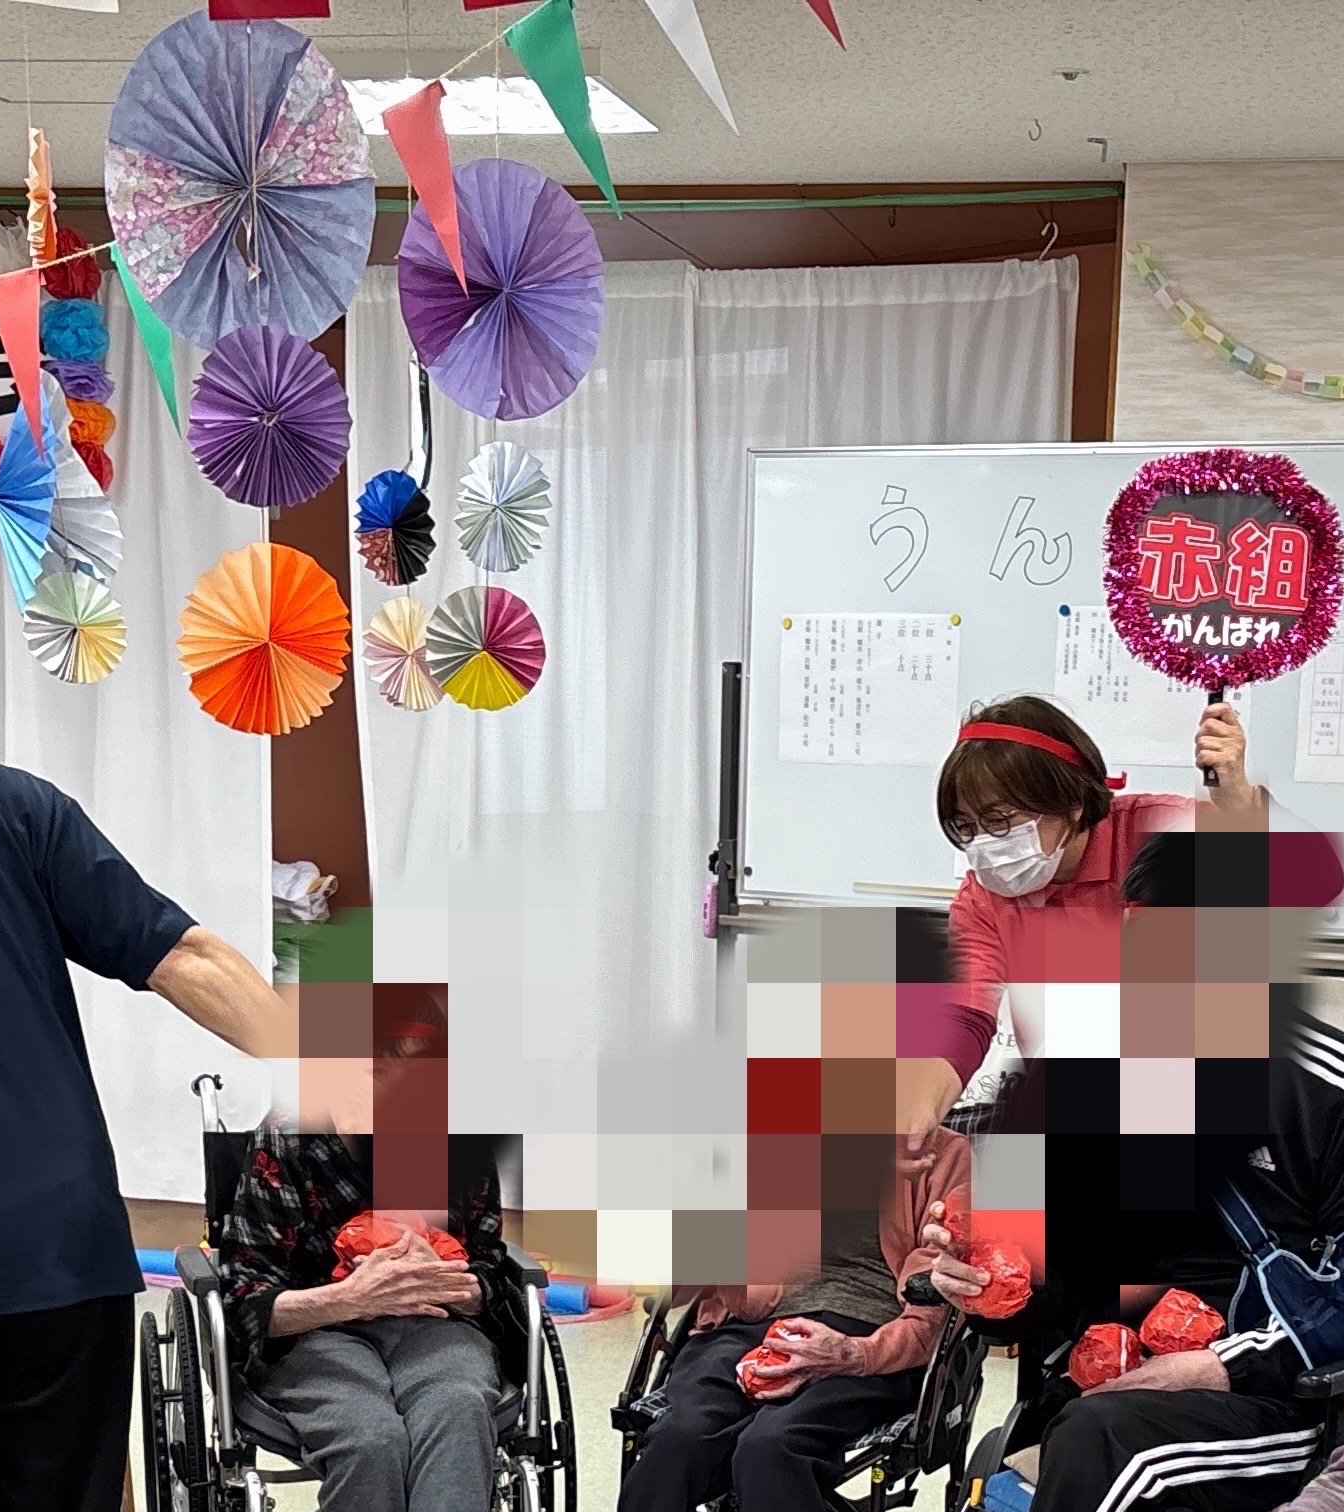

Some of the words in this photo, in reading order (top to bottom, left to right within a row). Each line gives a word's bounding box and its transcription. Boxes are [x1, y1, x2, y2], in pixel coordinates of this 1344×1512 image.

[1137, 516, 1310, 611] 赤組
[1161, 613, 1281, 647] がんばれ
